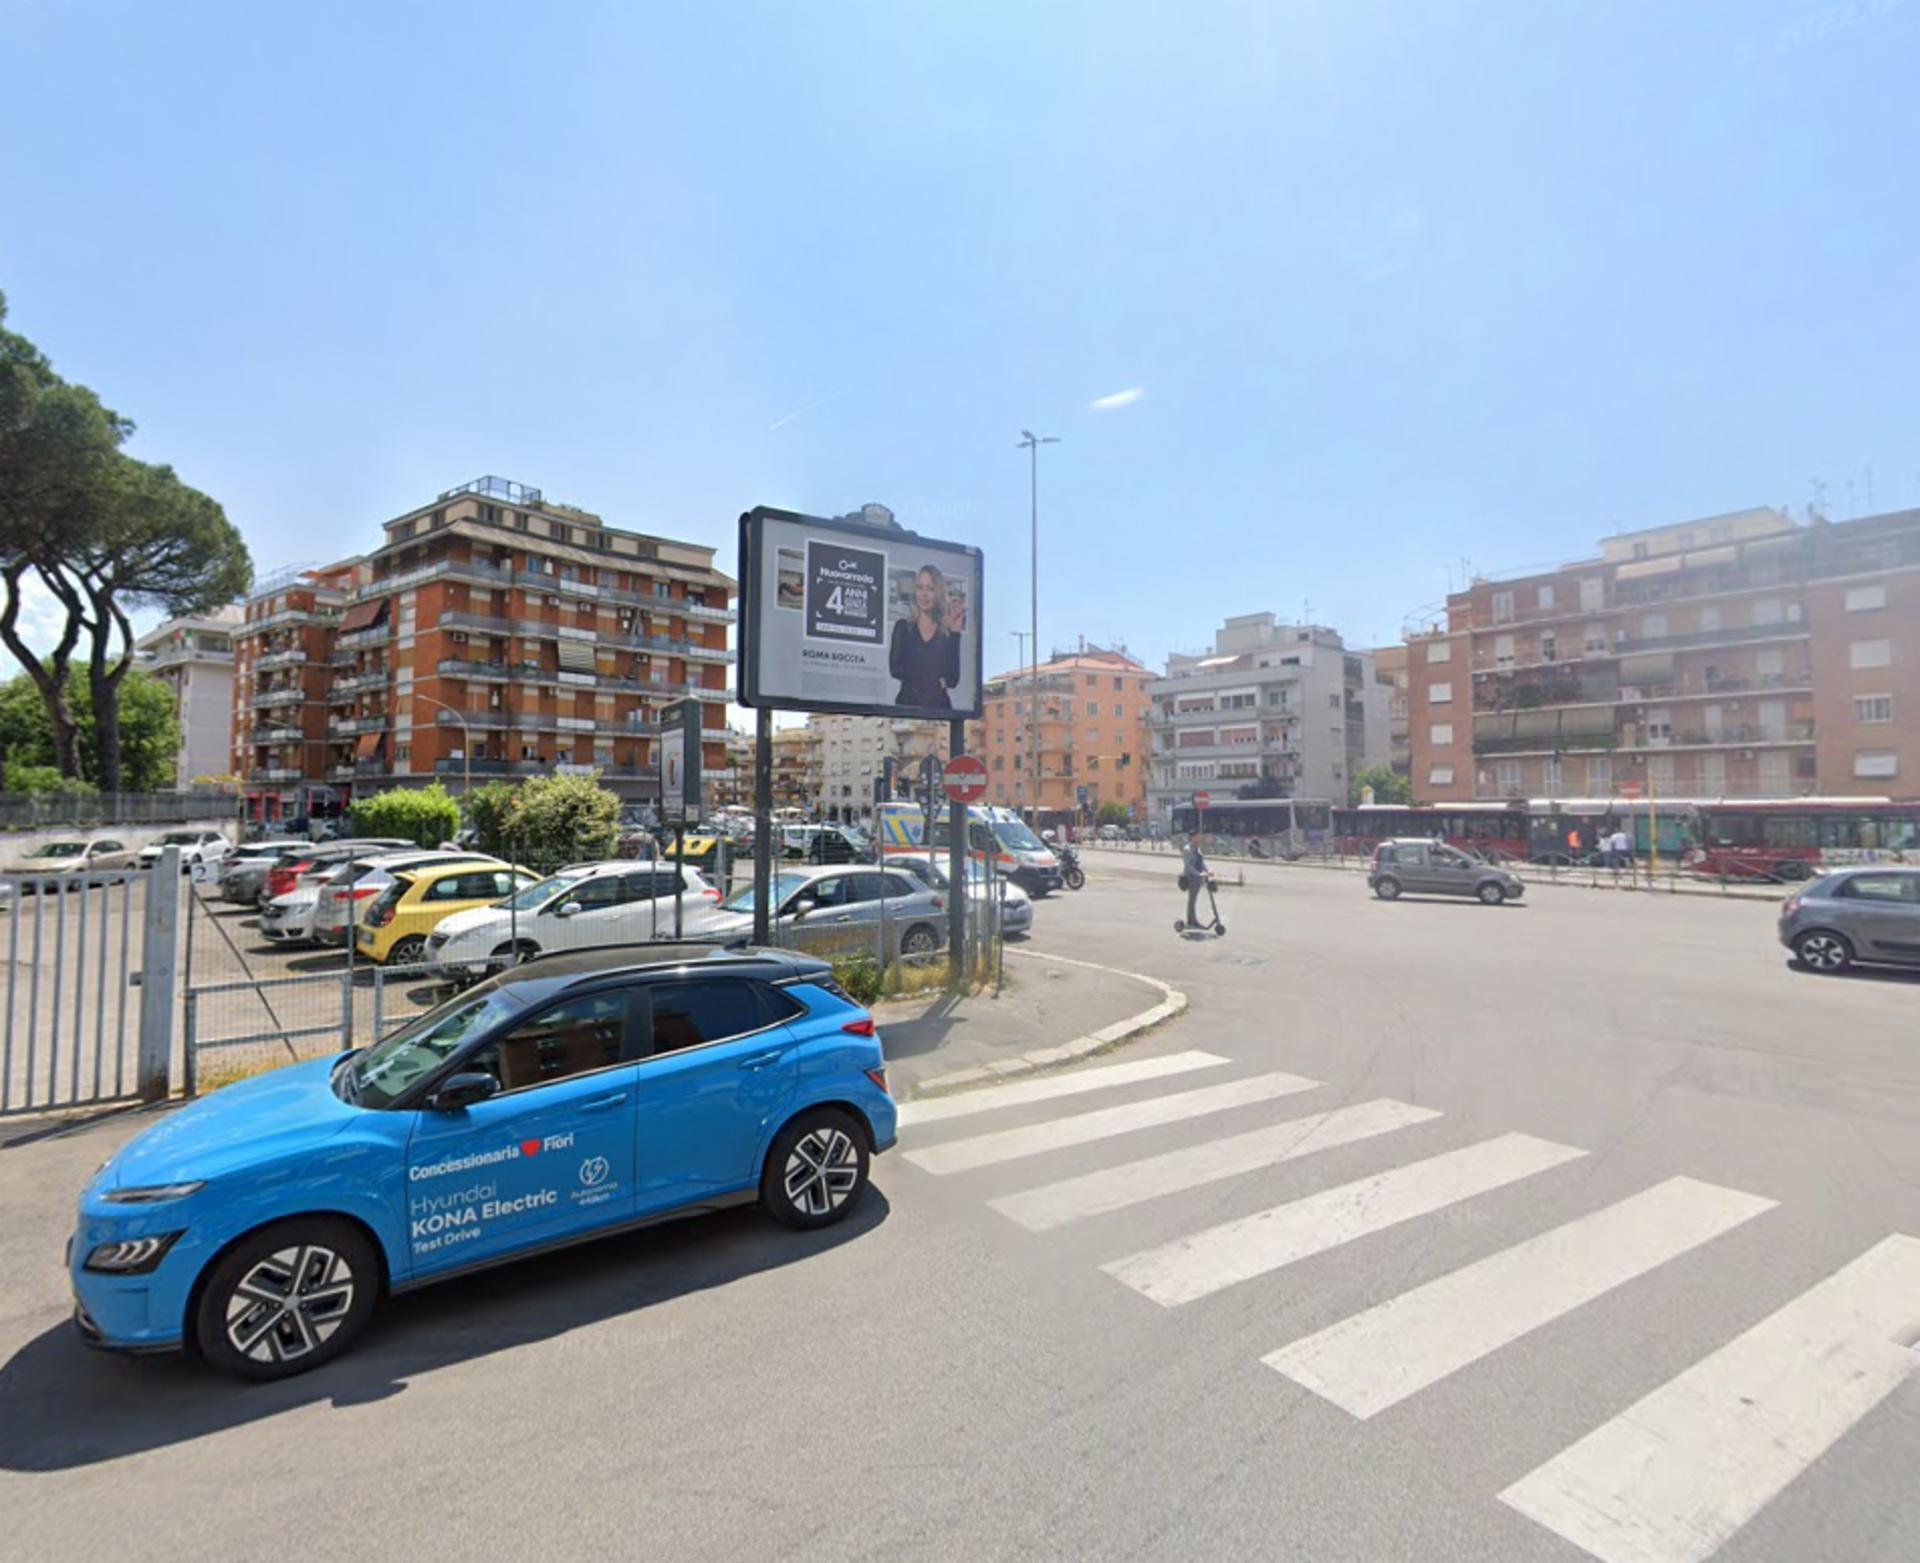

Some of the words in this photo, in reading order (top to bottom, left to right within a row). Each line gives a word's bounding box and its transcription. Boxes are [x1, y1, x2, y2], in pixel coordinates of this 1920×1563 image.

[826, 586, 843, 614] 4
[802, 649, 829, 659] ROMA
[195, 865, 206, 883] 2
[409, 1145, 520, 1181] Concessionaria
[543, 1132, 574, 1152] Fiori
[410, 1181, 496, 1215] Hyundai
[411, 1209, 478, 1238] KONA
[482, 1188, 557, 1219] Electric
[413, 1236, 443, 1254] Test
[444, 1226, 481, 1245] Drive
